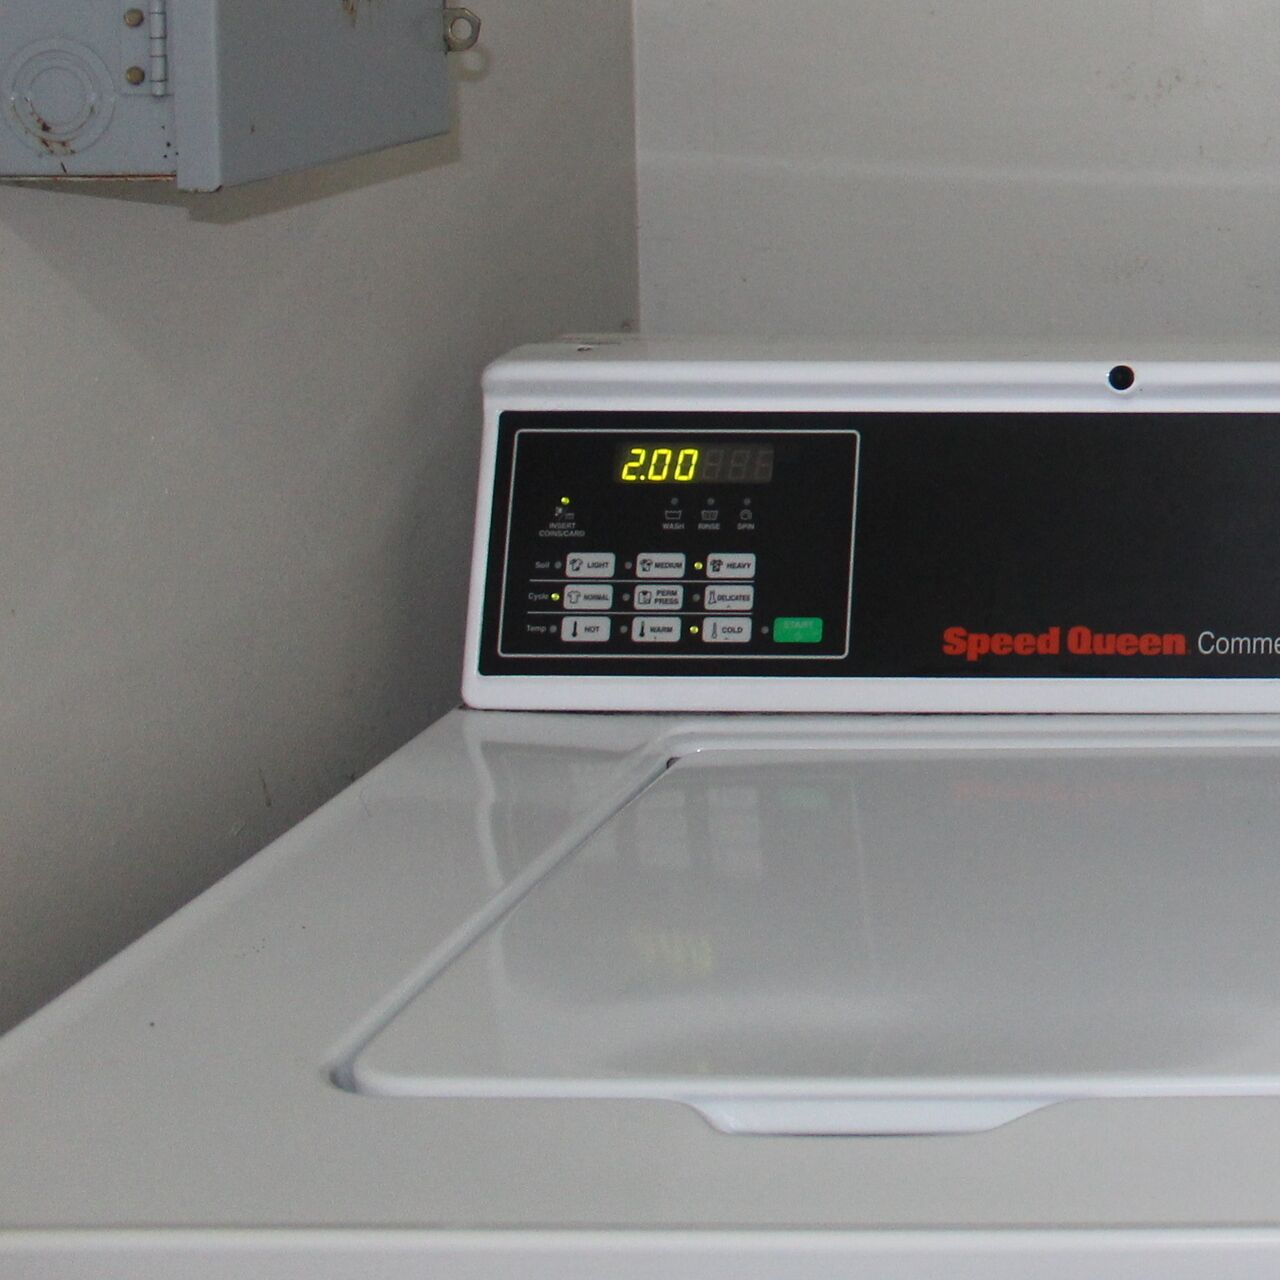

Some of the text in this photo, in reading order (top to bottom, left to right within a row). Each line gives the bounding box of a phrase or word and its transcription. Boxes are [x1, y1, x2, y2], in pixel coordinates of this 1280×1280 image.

[621, 448, 699, 482] 2.00
[586, 561, 609, 570] LIGHT
[654, 561, 684, 570] MEDIUM
[725, 561, 752, 570] HEAVY
[582, 593, 610, 601] NORMAL
[656, 589, 678, 597] PERM
[716, 593, 751, 602] DELICATES
[653, 597, 680, 605] PRESS
[584, 625, 600, 633] HOT
[650, 625, 673, 633] WARM
[721, 625, 744, 634] COLD
[943, 625, 1061, 661] Speed
[1067, 625, 1187, 656] Queen
